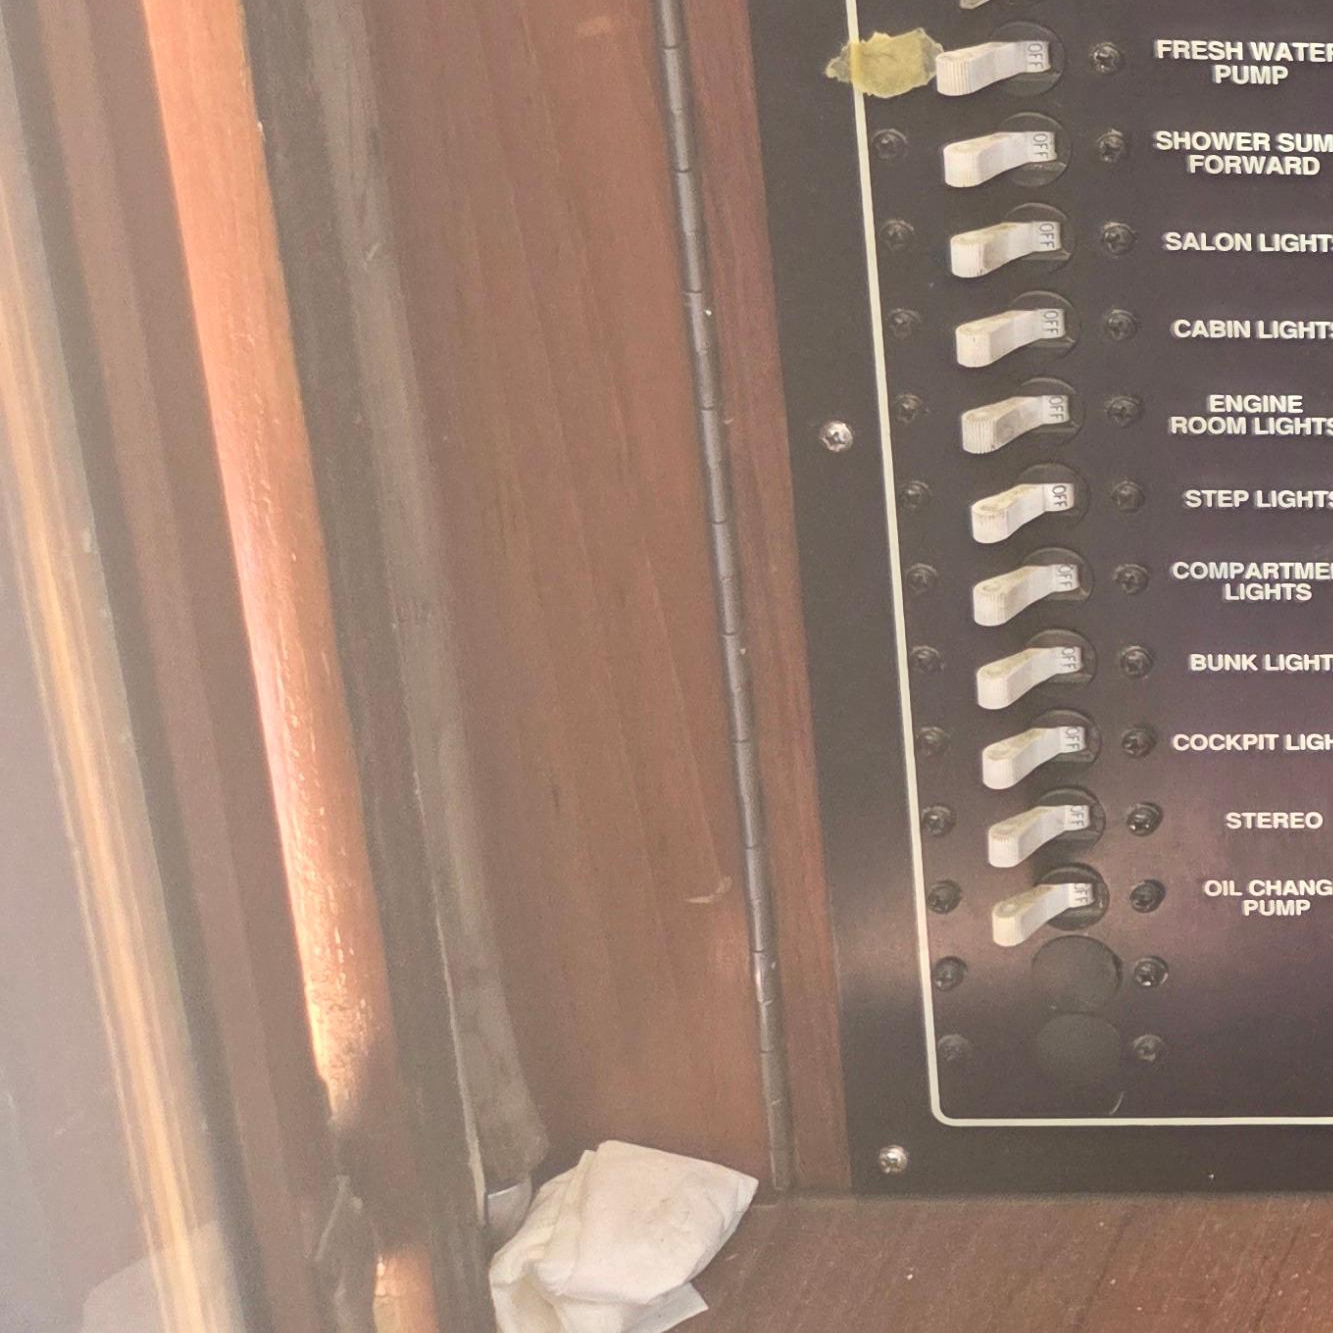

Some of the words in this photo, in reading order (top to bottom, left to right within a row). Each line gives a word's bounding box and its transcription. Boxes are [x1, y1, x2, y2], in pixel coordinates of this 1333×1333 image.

[1156, 40, 1243, 60] FRESH
[1214, 65, 1288, 84] PUMP
[1225, 583, 1312, 600] LIGHTS
[1226, 812, 1323, 829] STEREO
